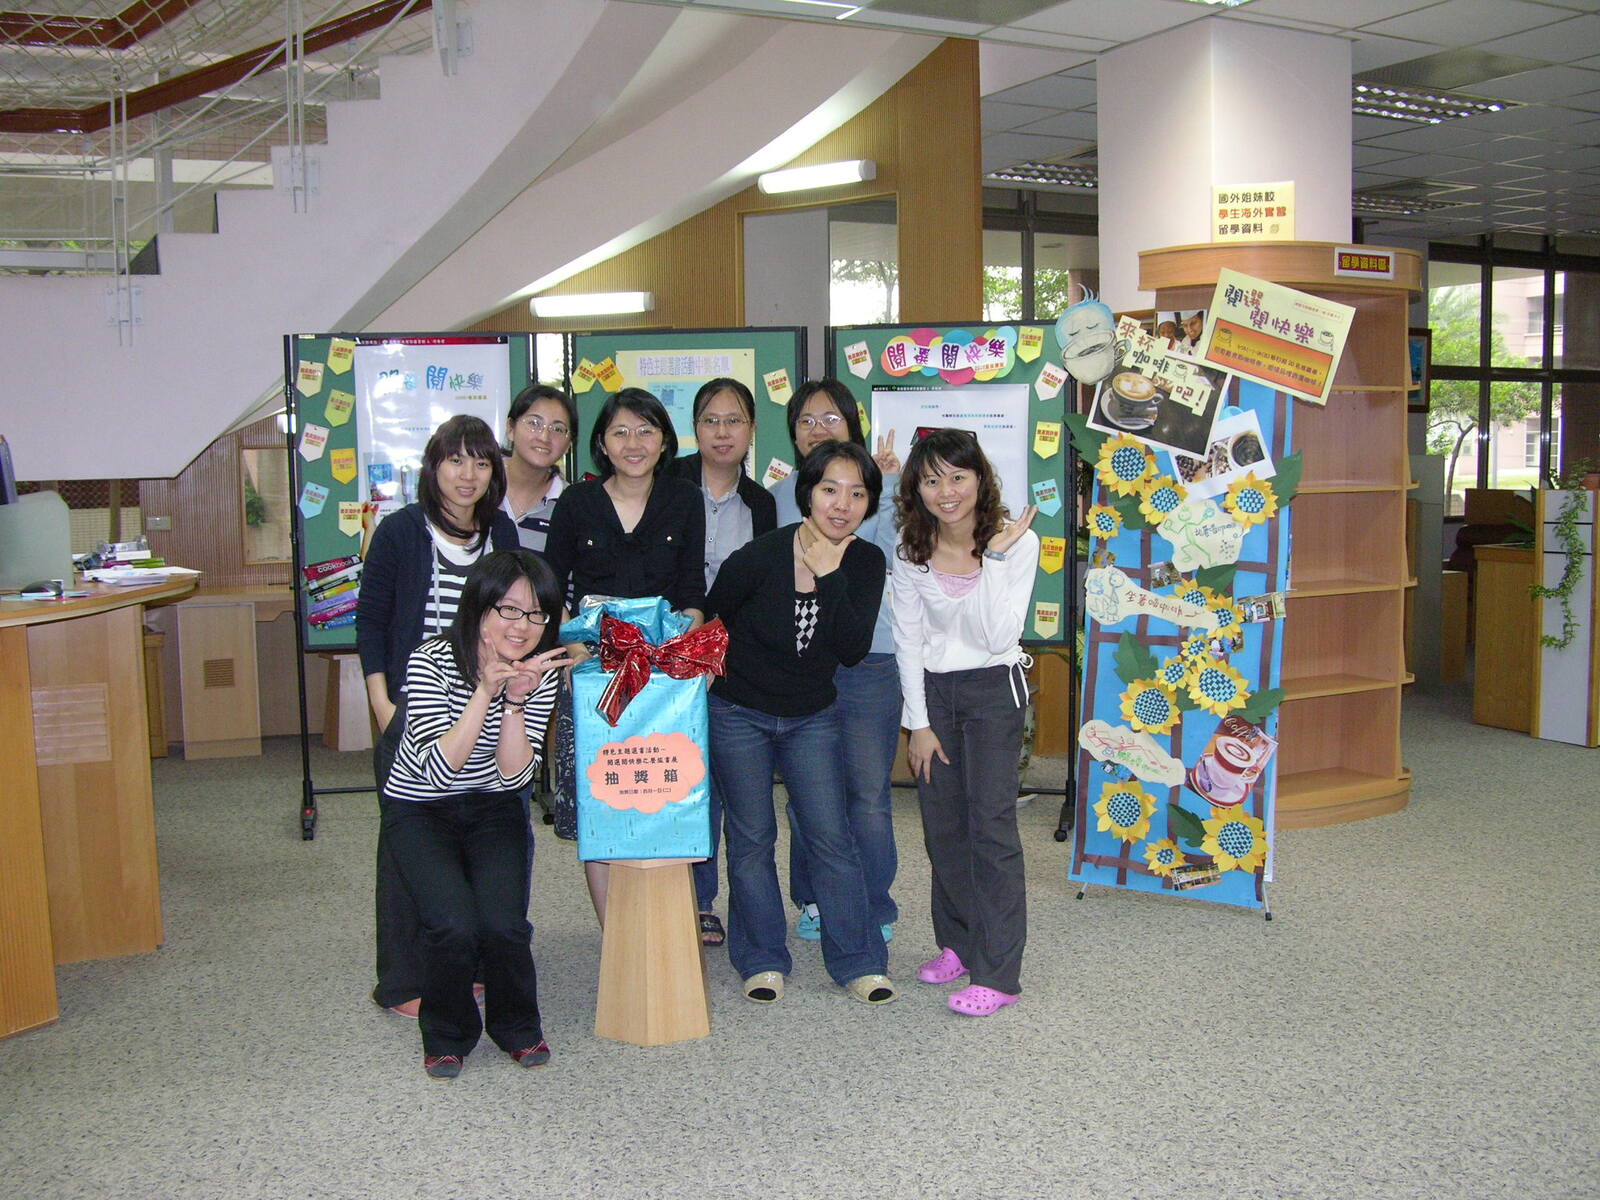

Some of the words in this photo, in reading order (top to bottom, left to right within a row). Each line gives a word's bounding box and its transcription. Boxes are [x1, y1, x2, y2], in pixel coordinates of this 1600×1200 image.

[1132, 350, 1170, 374] 咖啡
[1224, 717, 1257, 743] Coffee
[604, 768, 678, 786] 抽獎箱
